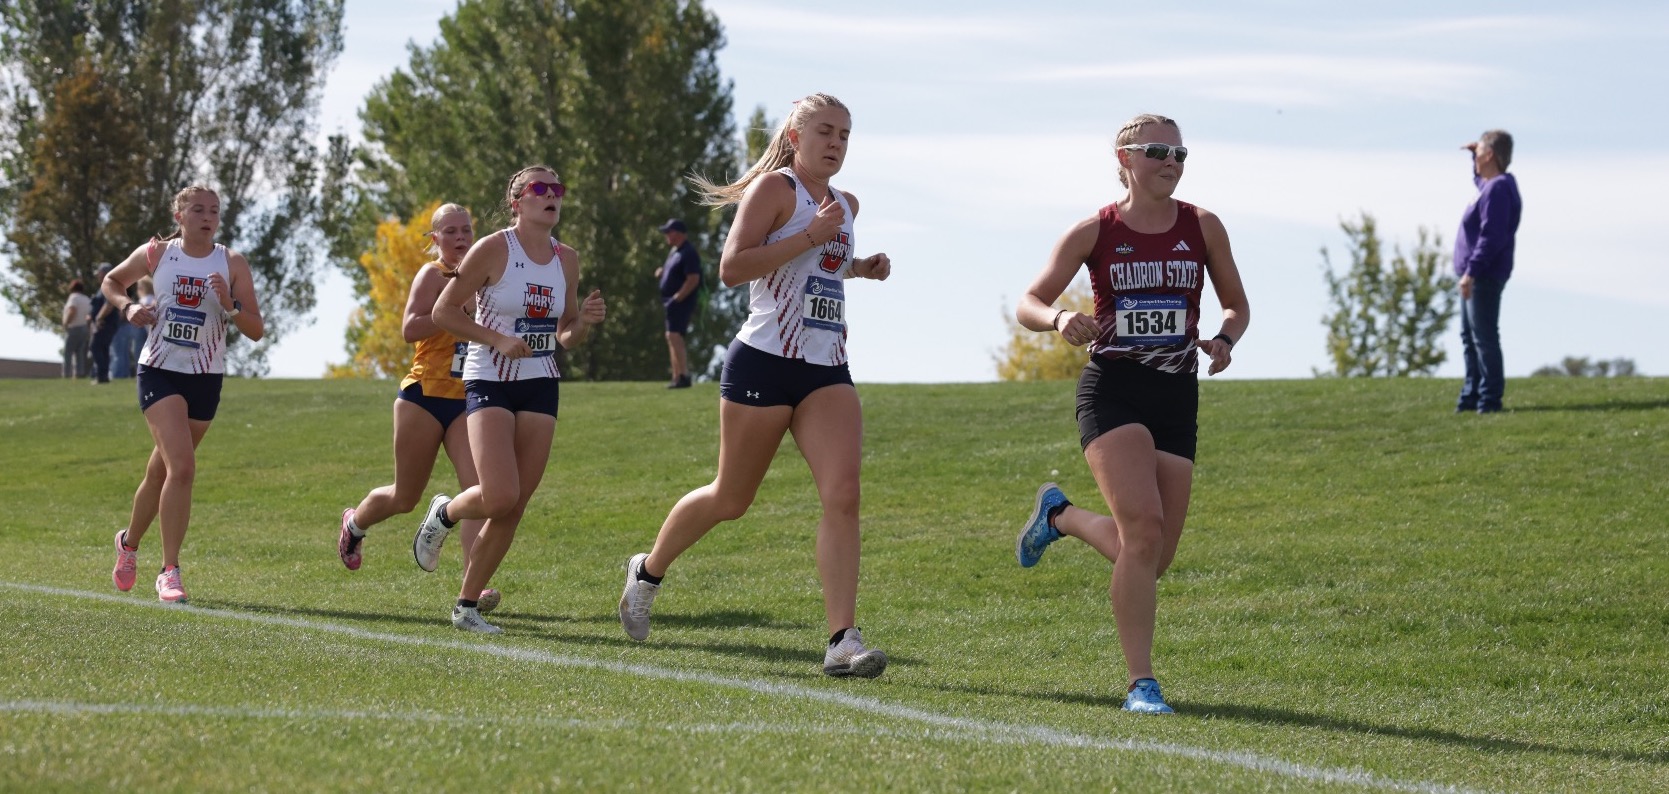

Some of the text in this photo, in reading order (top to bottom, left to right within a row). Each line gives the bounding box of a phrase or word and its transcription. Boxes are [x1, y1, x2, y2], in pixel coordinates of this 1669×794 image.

[821, 239, 851, 261] MARY
[1109, 260, 1199, 291] CHADRON STATE
[173, 283, 208, 299] MARY
[523, 291, 555, 311] MARY
[810, 297, 842, 322] 1664
[168, 322, 199, 341] 1661
[1124, 310, 1177, 335] 1534
